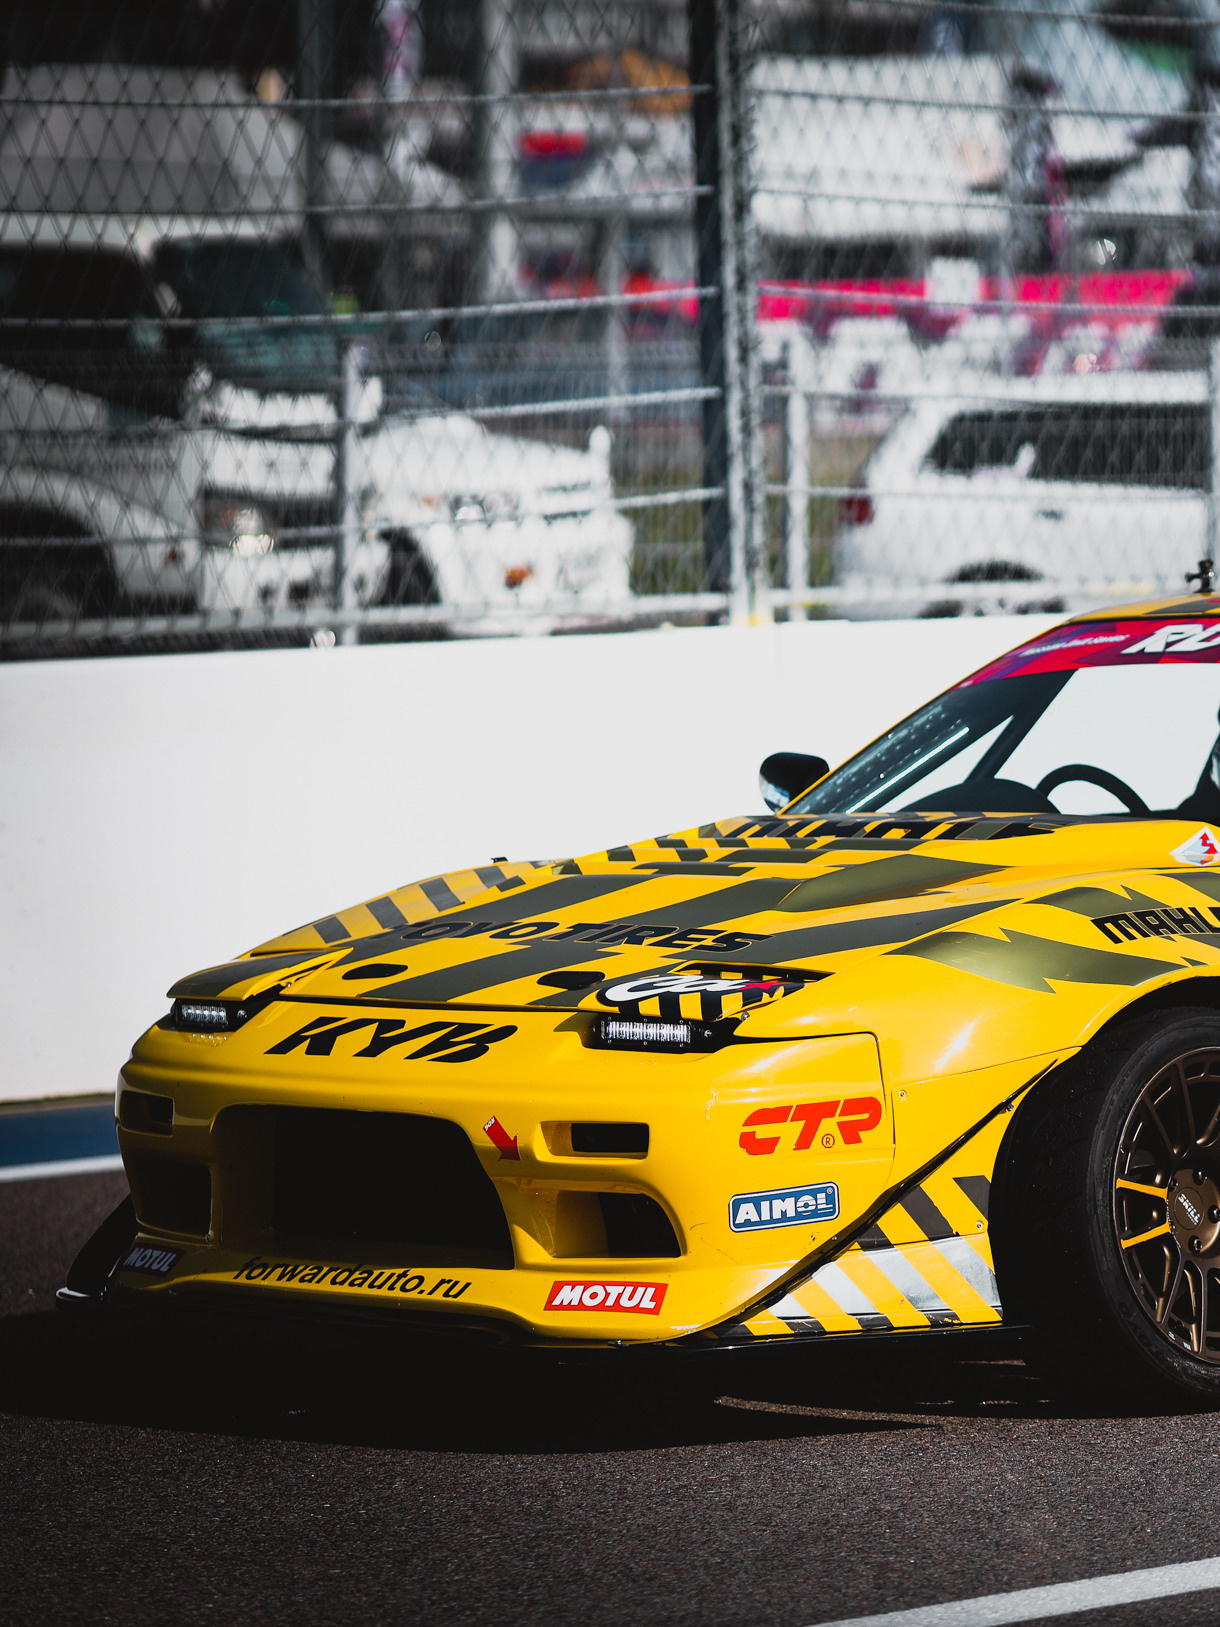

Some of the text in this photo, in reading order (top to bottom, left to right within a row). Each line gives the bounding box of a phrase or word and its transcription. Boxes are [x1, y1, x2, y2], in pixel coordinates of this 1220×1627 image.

[543, 922, 776, 953] TIRES
[264, 1016, 518, 1063] KYB
[735, 1193, 833, 1224] AIMOL
[123, 1248, 177, 1271] MOTUL
[233, 1256, 473, 1299] forwardauto.ru
[551, 1284, 658, 1310] MOTUL
